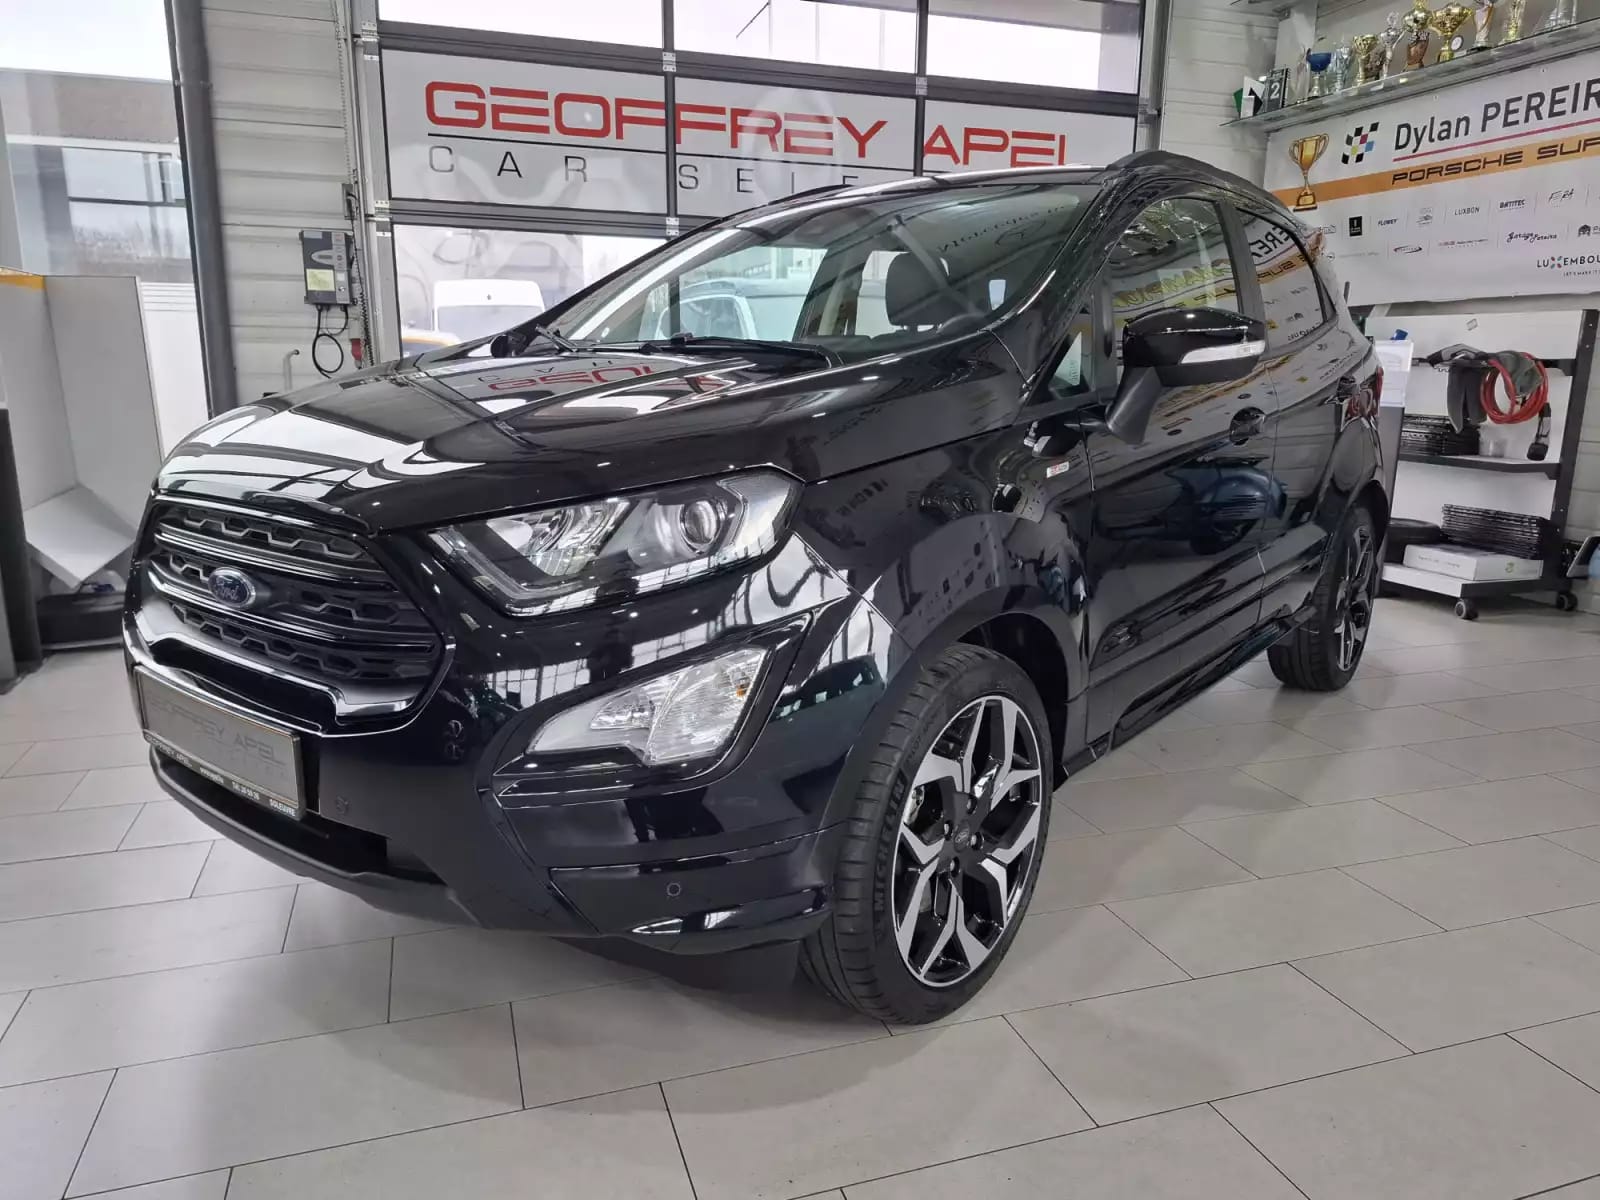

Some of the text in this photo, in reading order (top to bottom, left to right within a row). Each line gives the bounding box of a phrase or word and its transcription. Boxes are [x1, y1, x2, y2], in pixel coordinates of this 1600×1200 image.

[1270, 82, 1281, 99] 2
[424, 81, 888, 159] GEOFFREY
[1394, 114, 1471, 153] Dylan
[429, 145, 588, 183] CAR
[1391, 150, 1524, 185] PORSCHE
[873, 768, 908, 912] MICHELIN
